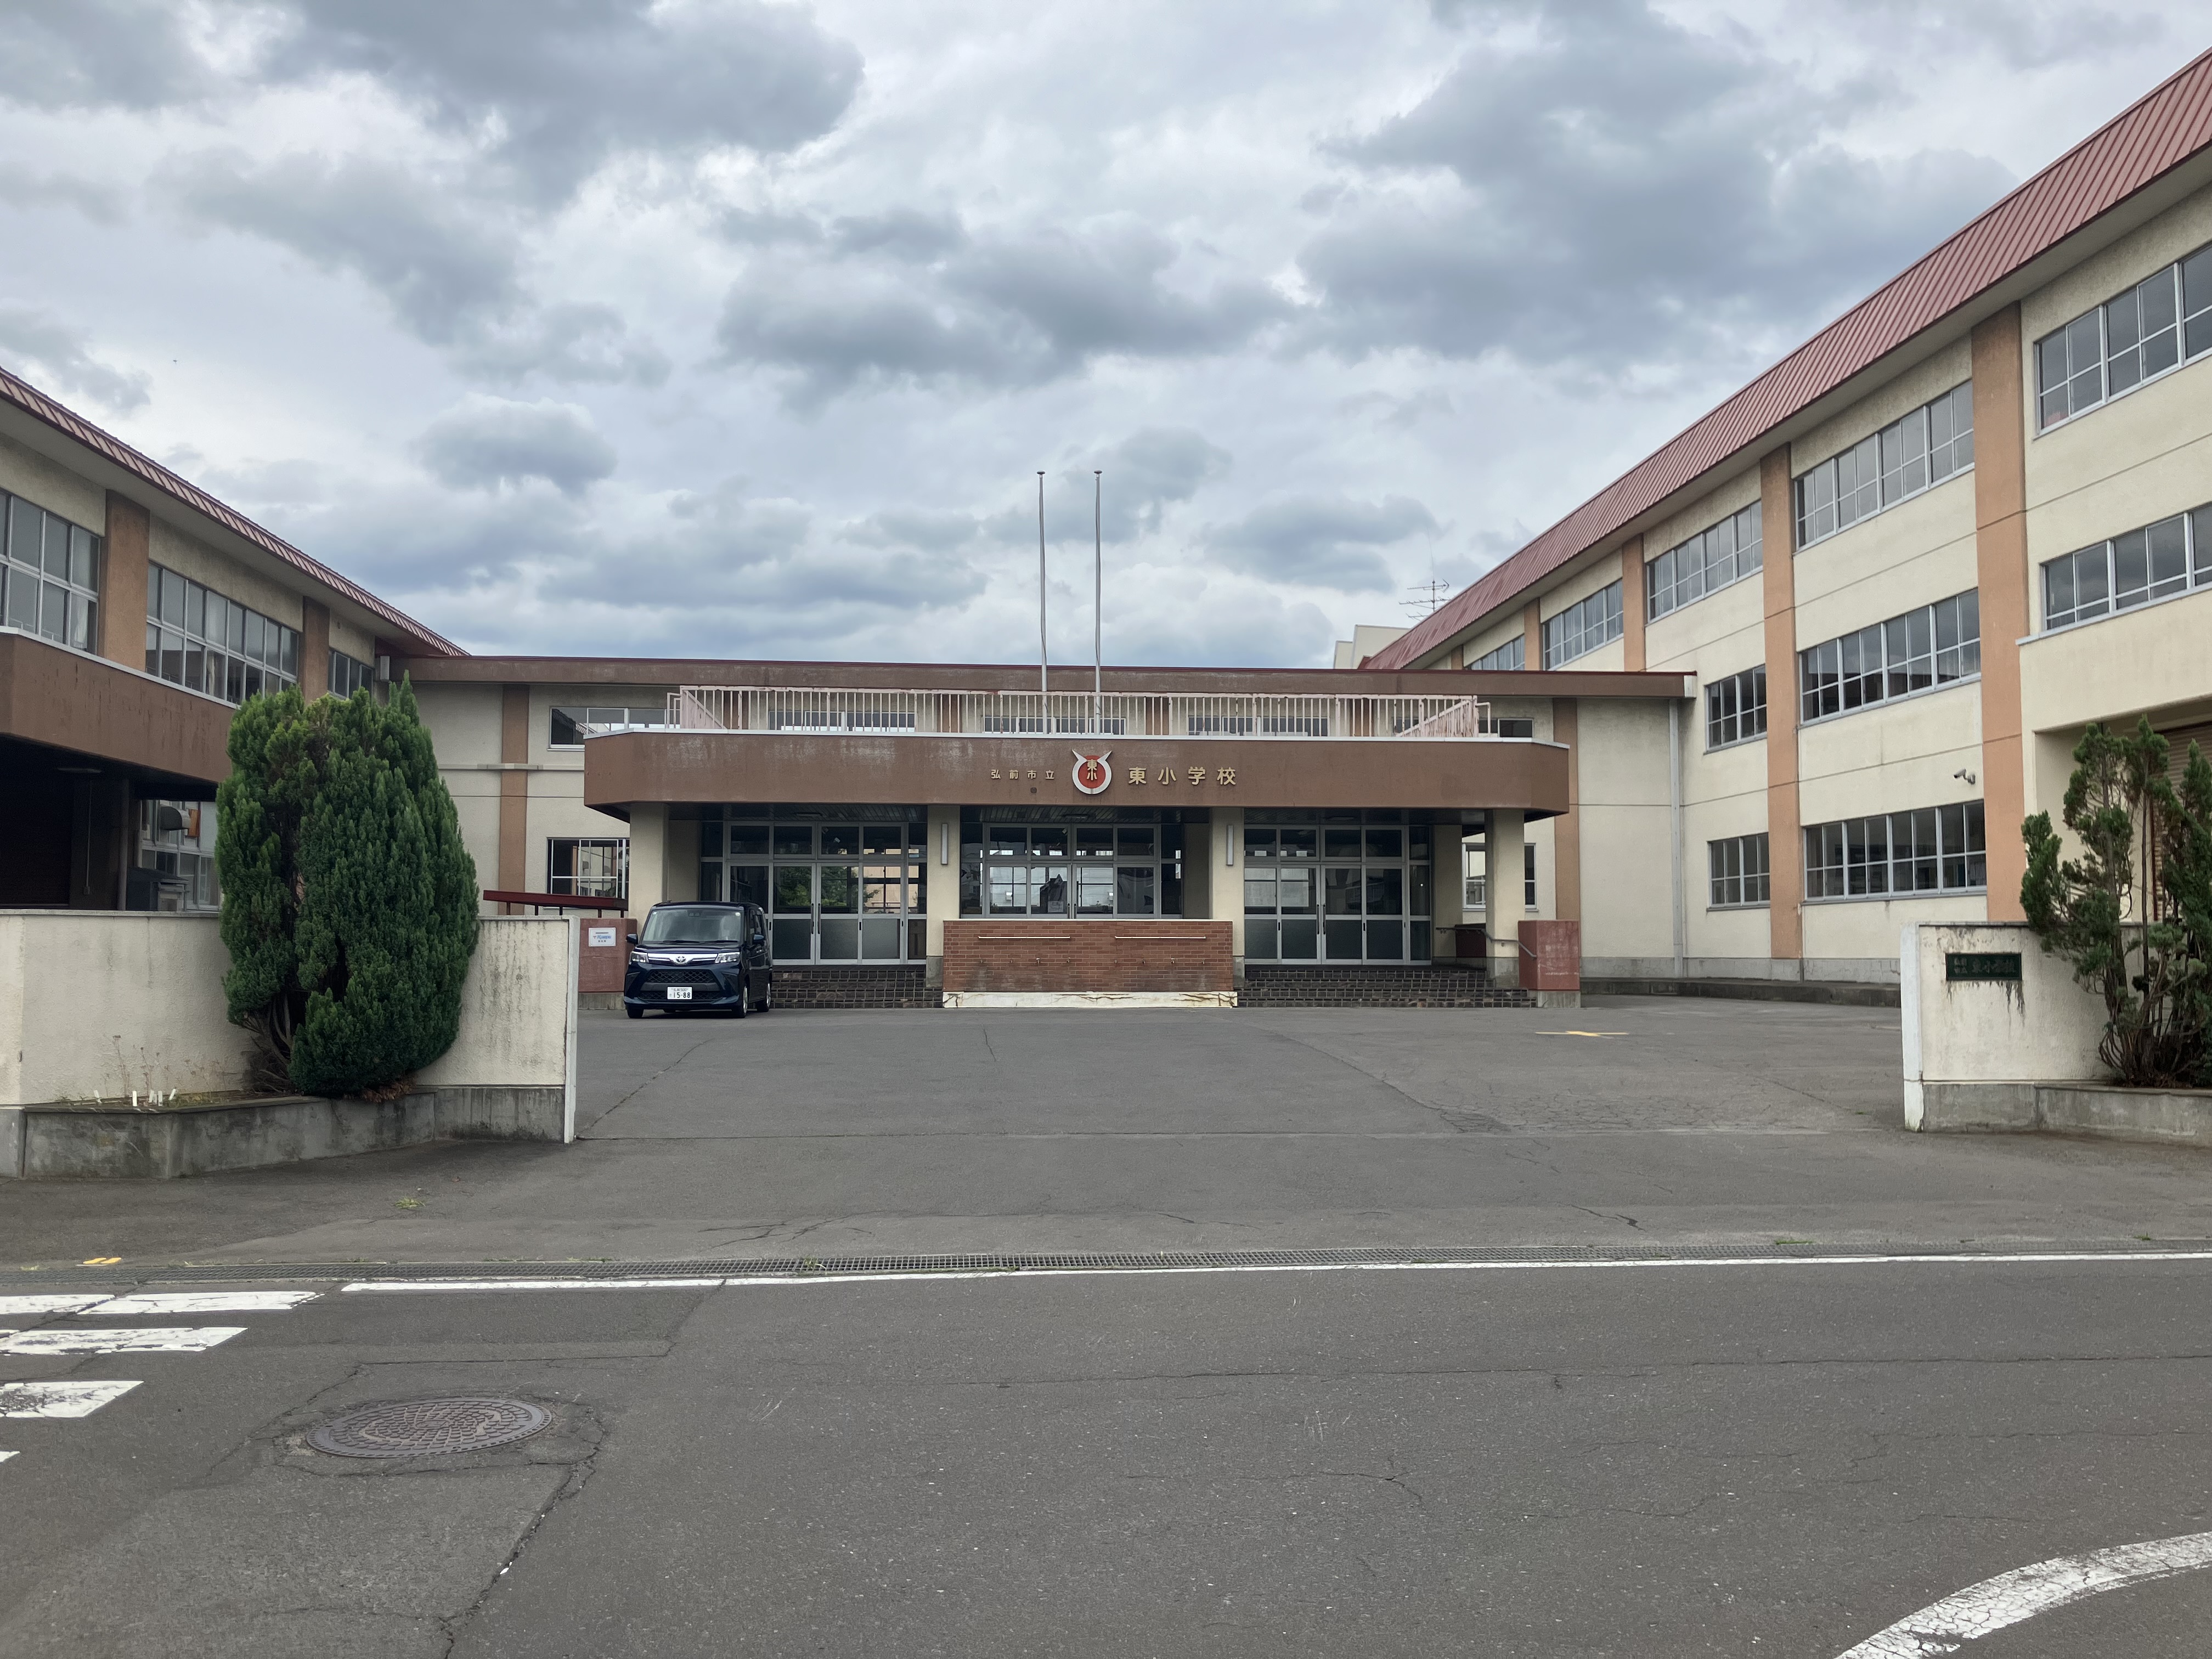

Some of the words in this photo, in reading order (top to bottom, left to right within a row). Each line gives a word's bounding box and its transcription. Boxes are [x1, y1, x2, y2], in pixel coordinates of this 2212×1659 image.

[991, 769, 1054, 779] 弘前市立
[1128, 766, 1236, 785] 東小学校
[1086, 759, 1098, 781] 東小
